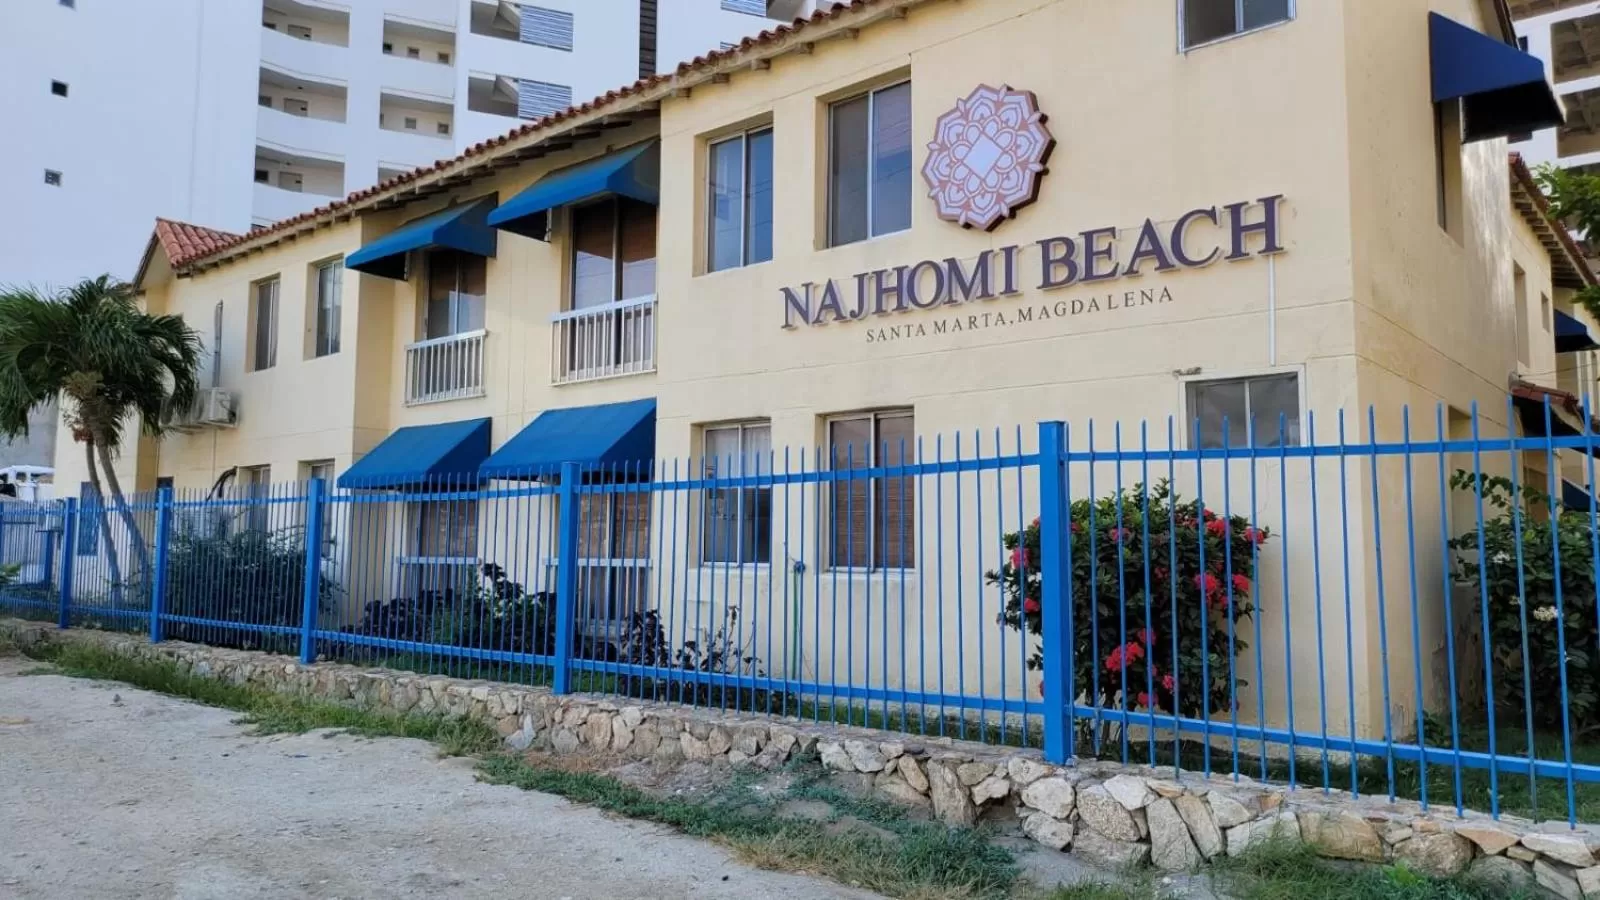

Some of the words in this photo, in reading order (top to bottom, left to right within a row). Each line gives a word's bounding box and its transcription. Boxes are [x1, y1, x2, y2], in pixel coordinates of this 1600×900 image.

[780, 245, 1020, 329] NAJHOMI
[1036, 194, 1284, 289] BEACH
[866, 323, 927, 343] SANTA
[1017, 286, 1174, 323] MAGDALENA
